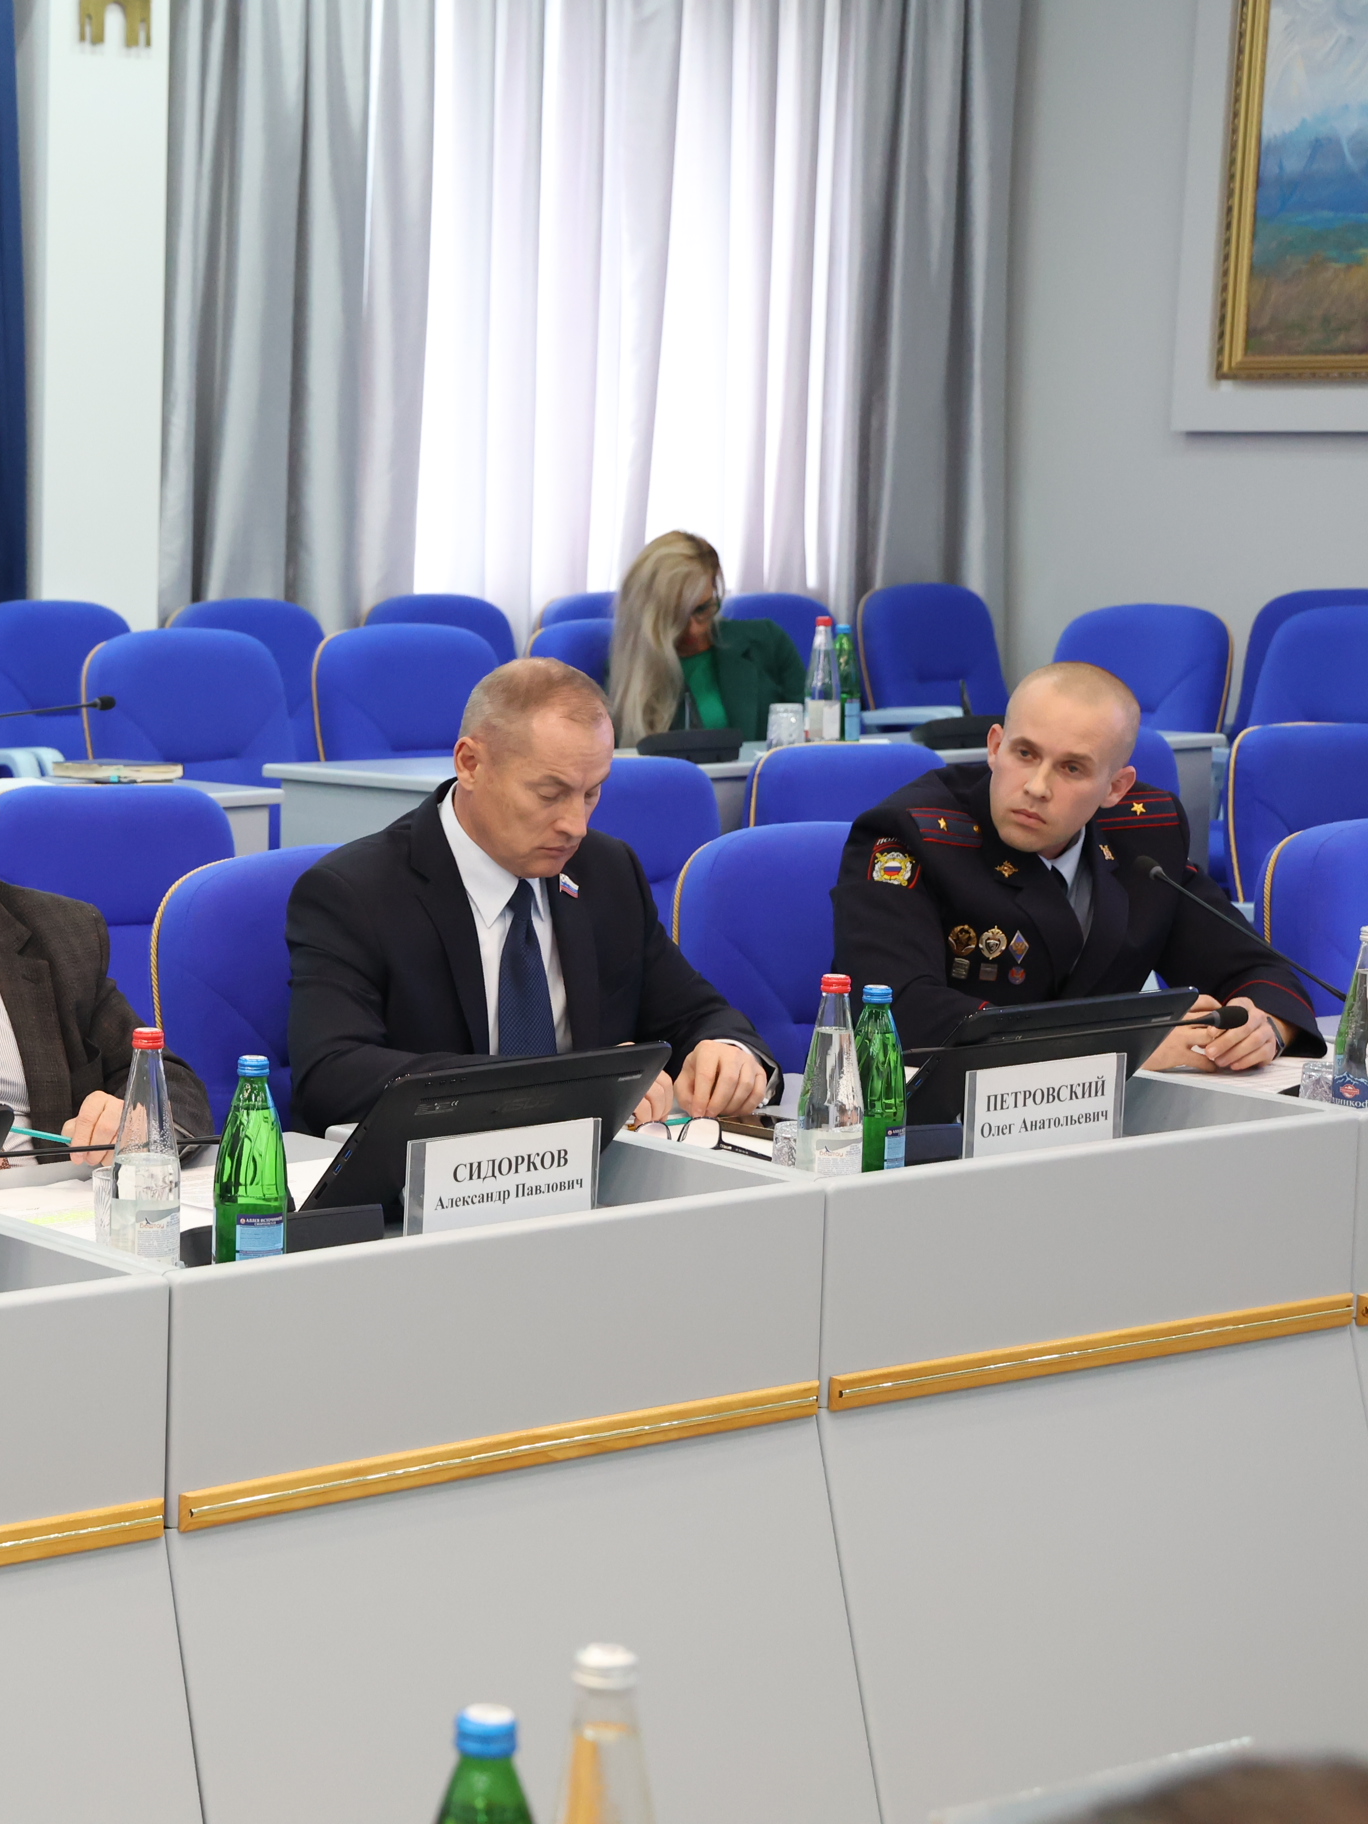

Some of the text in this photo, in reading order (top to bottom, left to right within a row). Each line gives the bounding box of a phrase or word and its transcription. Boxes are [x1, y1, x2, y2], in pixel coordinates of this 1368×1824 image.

[986, 1075, 1106, 1112] ПЕТРОВСКИЙ
[980, 1110, 1109, 1139] Олег Анатольевич
[452, 1148, 569, 1184] СИДОРКОВ
[434, 1178, 584, 1211] Александр Павлович
